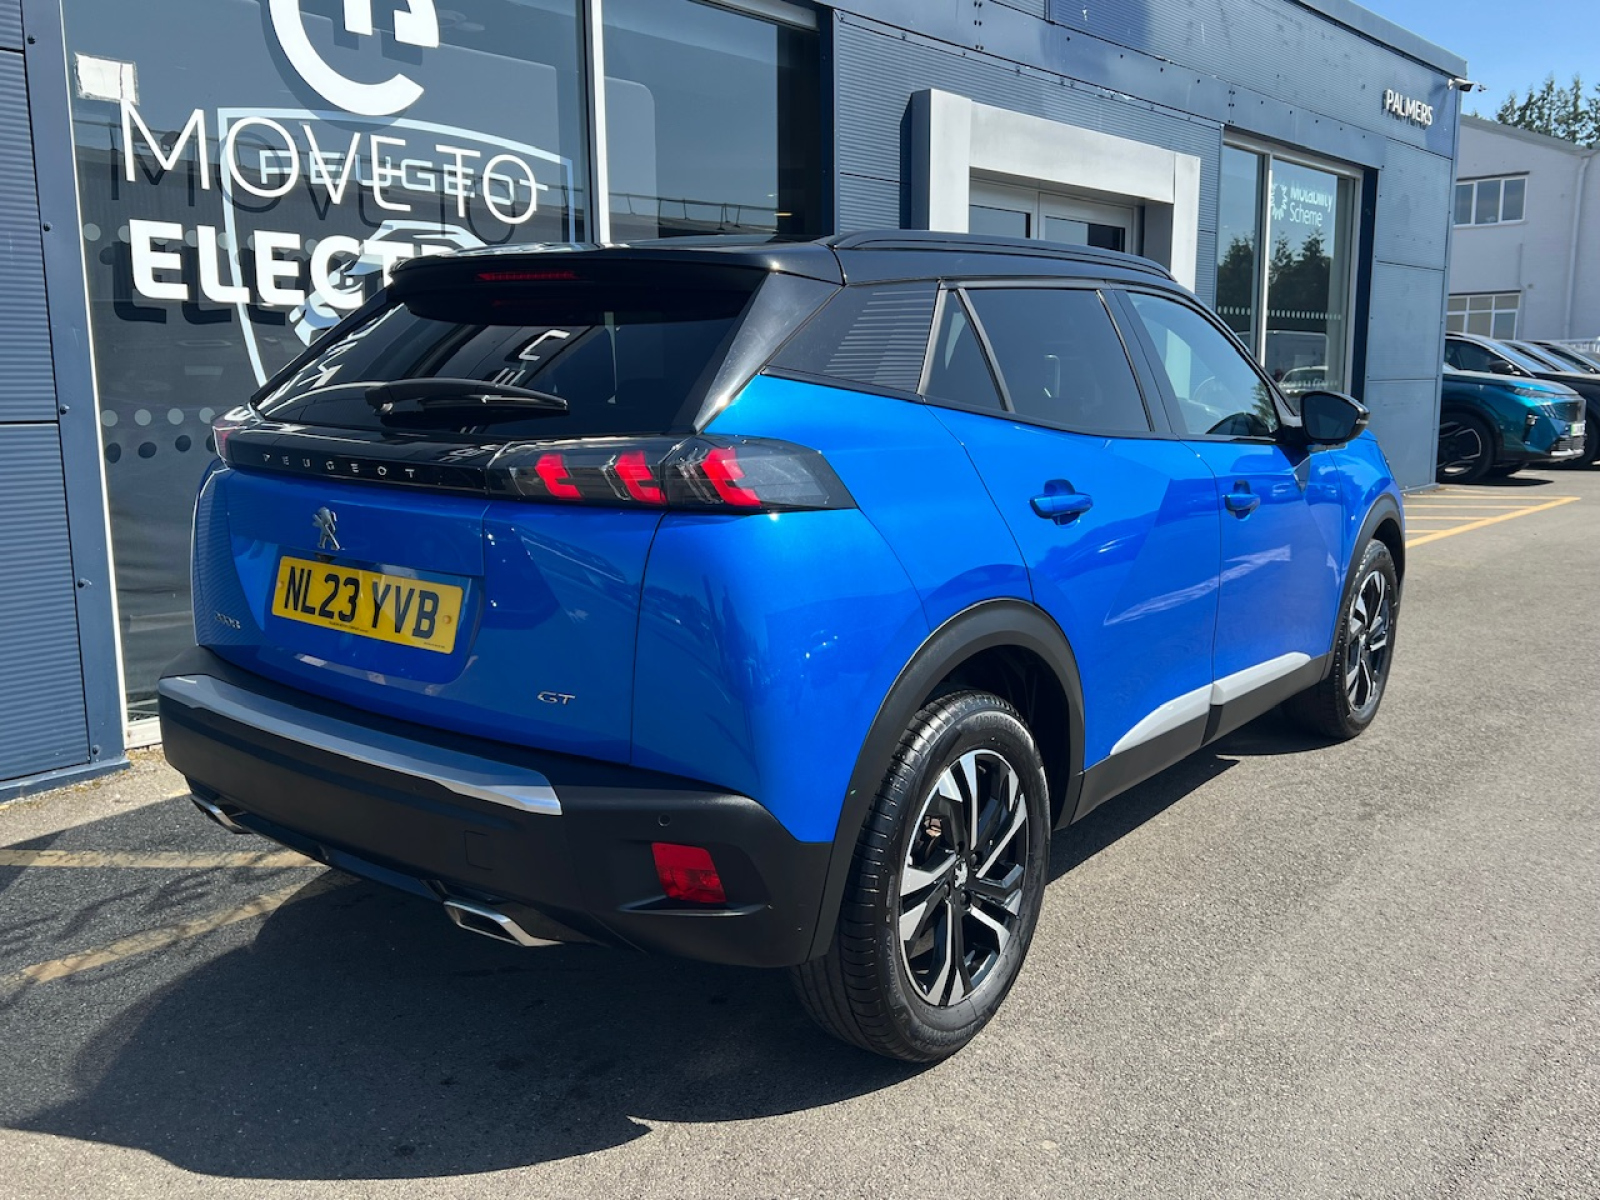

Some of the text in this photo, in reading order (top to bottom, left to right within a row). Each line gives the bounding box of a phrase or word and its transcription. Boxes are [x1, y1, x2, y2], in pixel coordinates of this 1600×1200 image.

[1384, 88, 1434, 126] PALMERS
[120, 102, 538, 225] MOVE TO
[259, 149, 549, 206] PEUGEOT
[1289, 201, 1323, 227] Scheme
[129, 219, 457, 310] ELECT
[262, 453, 415, 479] PEUGEOT
[283, 565, 440, 640] NL23 YVB
[537, 691, 576, 705] GT
